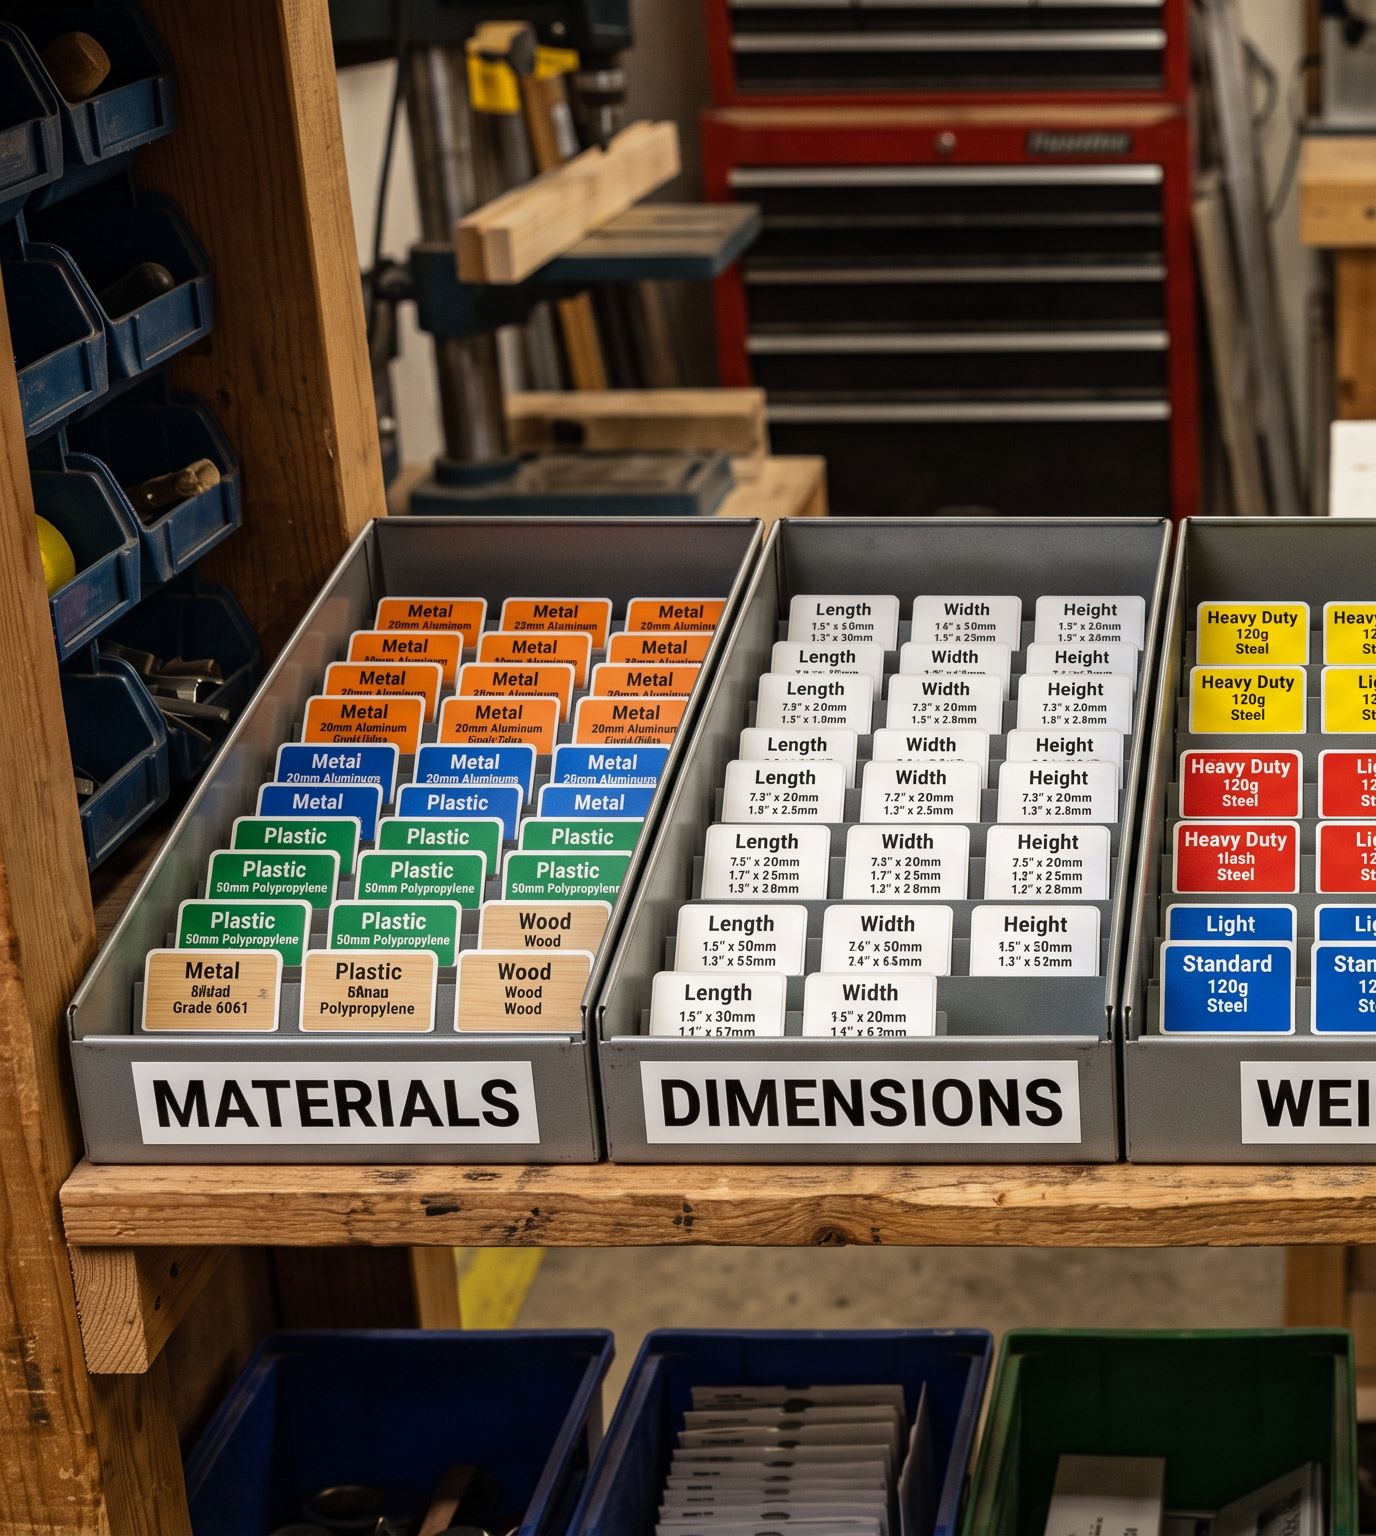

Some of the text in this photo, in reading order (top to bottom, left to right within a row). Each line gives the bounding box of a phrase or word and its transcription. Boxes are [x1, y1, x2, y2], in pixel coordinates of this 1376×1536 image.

[533, 605, 578, 618] Metal
[816, 602, 871, 619] Length
[944, 603, 989, 616] Width
[1064, 603, 1117, 619] Height
[1208, 611, 1298, 627] Heavy Duty
[1236, 628, 1268, 642] 120g
[382, 639, 428, 653] Metal
[512, 640, 557, 654] Metal
[922, 681, 969, 696] Width
[1048, 682, 1104, 700] Height
[475, 705, 523, 720] Metal
[320, 722, 407, 732] 20mm Aluminum
[455, 723, 542, 733] 20mm Aluminum
[451, 754, 500, 769] Metal
[755, 769, 815, 789] Length
[896, 769, 946, 785] Width
[1030, 769, 1088, 789] Height
[293, 793, 343, 809] Metal
[427, 794, 488, 810] Plastic
[264, 827, 327, 844] Plastic
[552, 828, 614, 845] Plastic
[736, 833, 798, 853] Length
[882, 833, 933, 849] Width
[1018, 833, 1079, 854] Height
[243, 860, 306, 878] Plastic
[252, 882, 328, 895] Polypropylene
[362, 912, 426, 930] Plastic
[519, 912, 571, 930] Wood
[709, 914, 774, 936] Length
[1004, 915, 1067, 934] Height
[373, 934, 450, 948] Polypropylene
[524, 934, 561, 947] Wood
[185, 961, 240, 979] Metal
[336, 962, 402, 980] Plastic
[498, 962, 551, 980] Wood
[505, 985, 542, 998] Wood
[685, 983, 752, 1003] Length
[173, 1001, 247, 1014] Grade 6061
[320, 1001, 415, 1018] Polypropylene
[504, 1002, 542, 1015] Wood
[706, 1014, 712, 1022] x
[153, 1079, 519, 1127] MATERIALS
[660, 1078, 1063, 1127] DIMENSIONS
